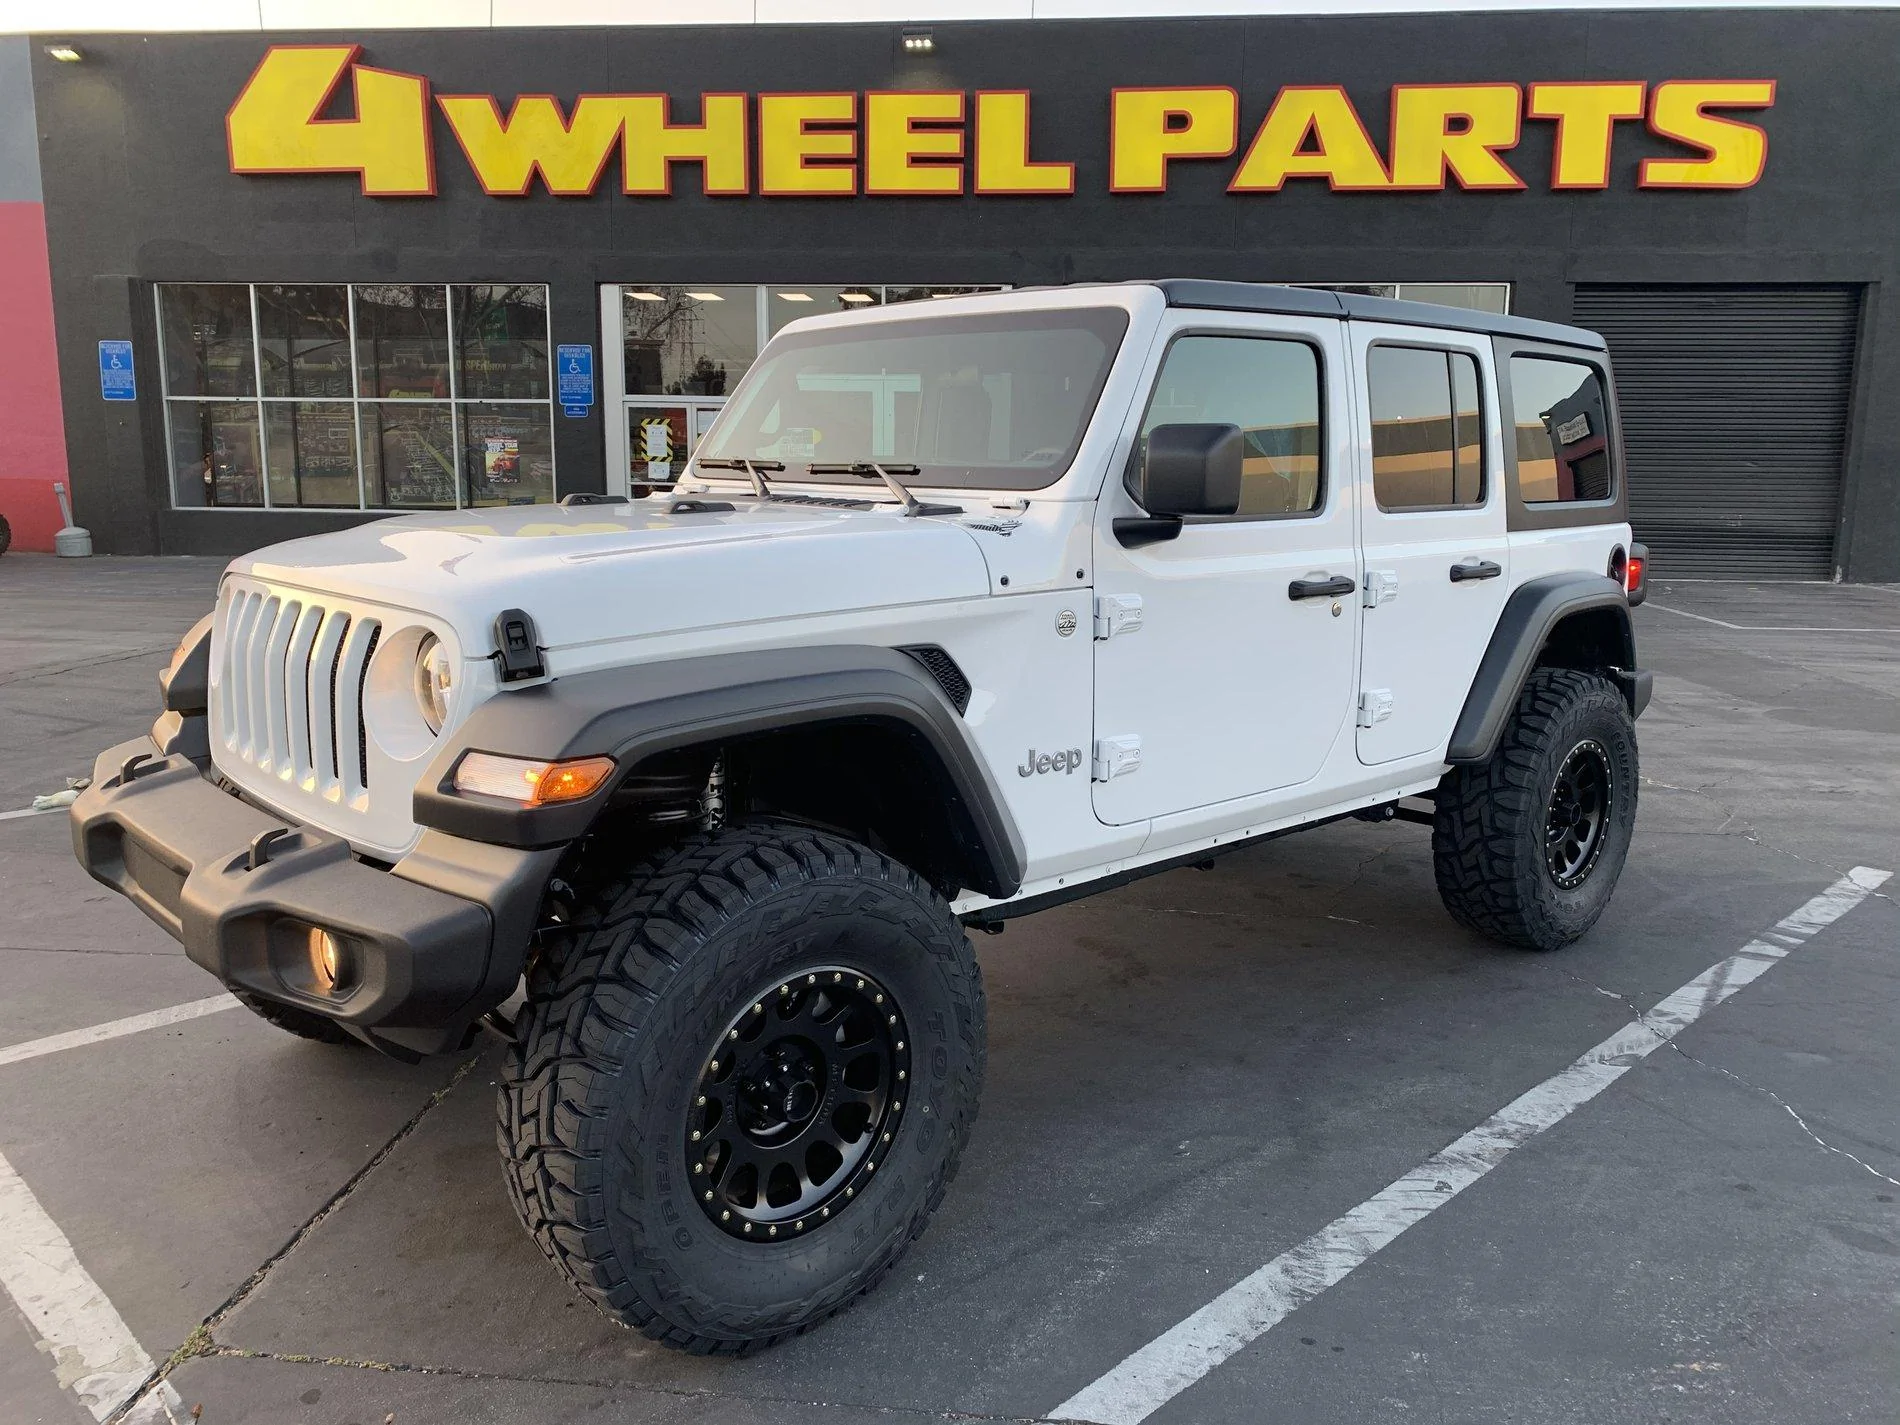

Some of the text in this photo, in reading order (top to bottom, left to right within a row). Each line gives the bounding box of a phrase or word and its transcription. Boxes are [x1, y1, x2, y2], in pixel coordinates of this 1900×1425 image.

[225, 44, 1777, 197] 4 WHEEL PARTS
[1018, 748, 1083, 778] Jeep
